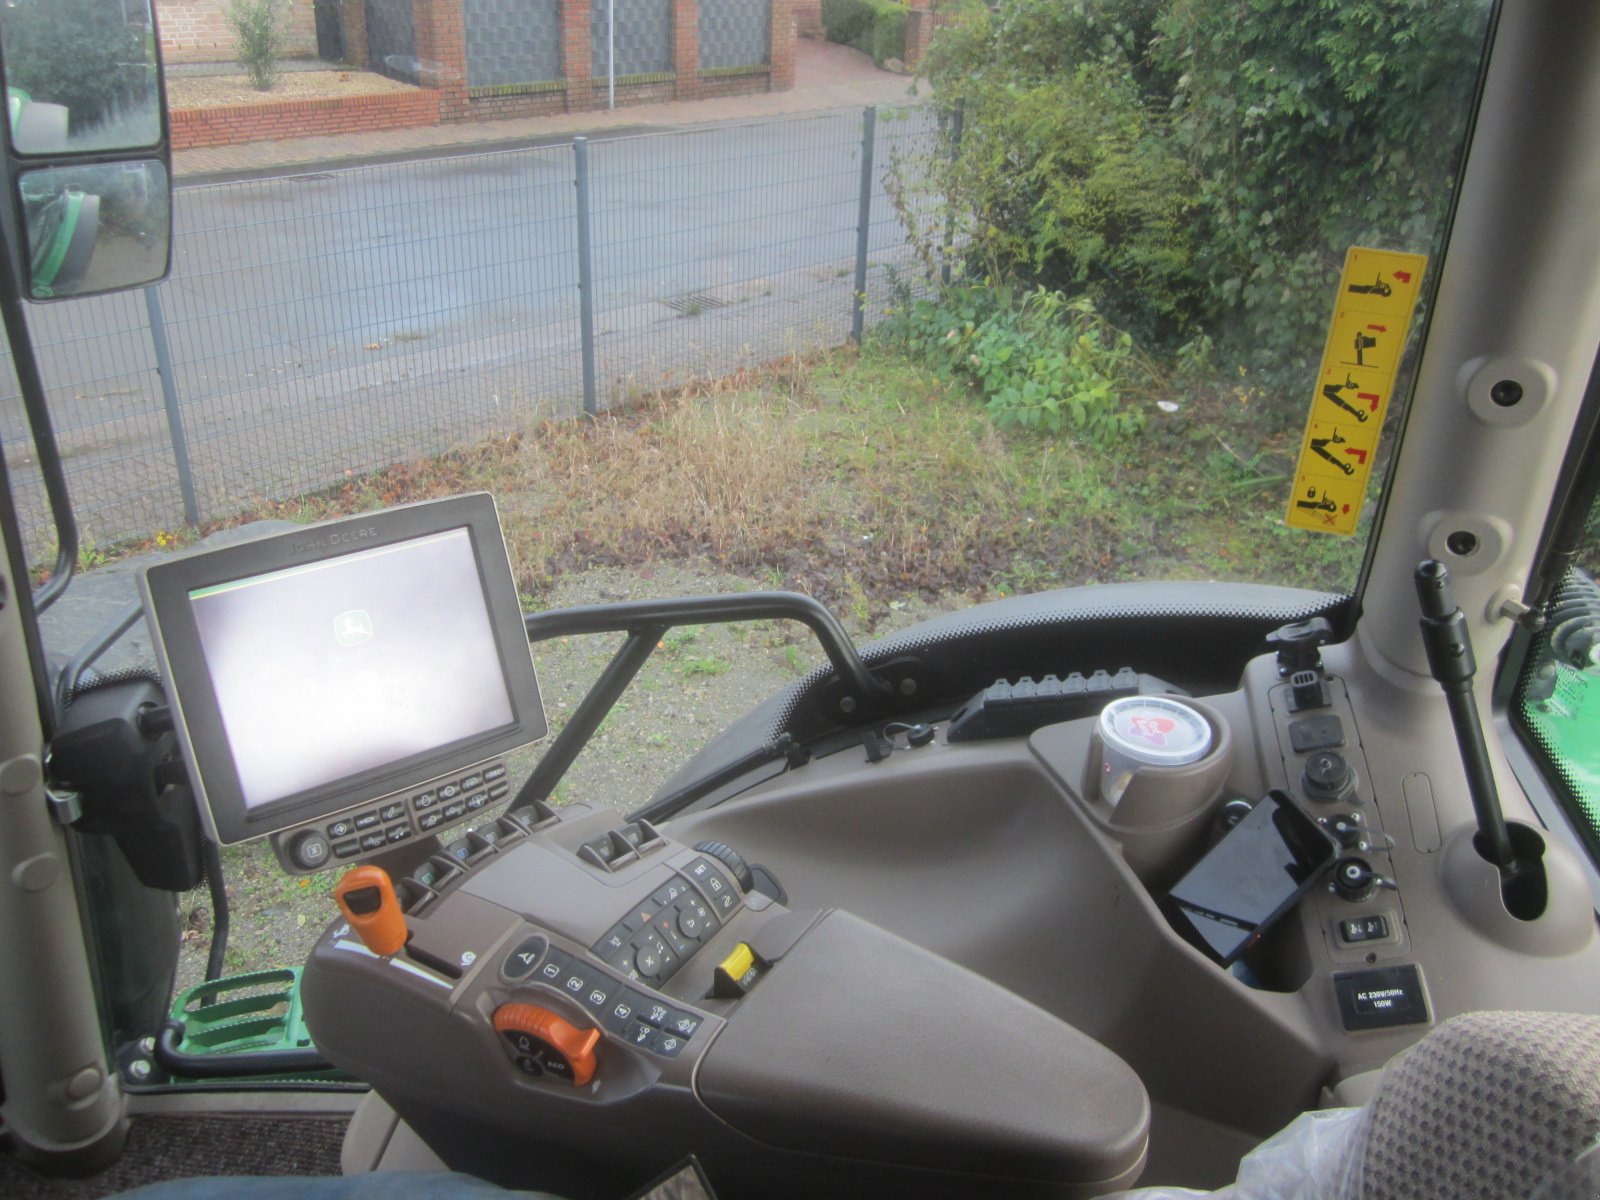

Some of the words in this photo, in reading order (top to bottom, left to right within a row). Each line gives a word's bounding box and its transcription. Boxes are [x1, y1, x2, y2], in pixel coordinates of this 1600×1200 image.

[329, 527, 378, 545] DEERE
[695, 864, 706, 875] SET
[1357, 991, 1367, 1000] AC
[1369, 988, 1403, 999] 230V/50Hz
[1373, 999, 1392, 1008] 150W
